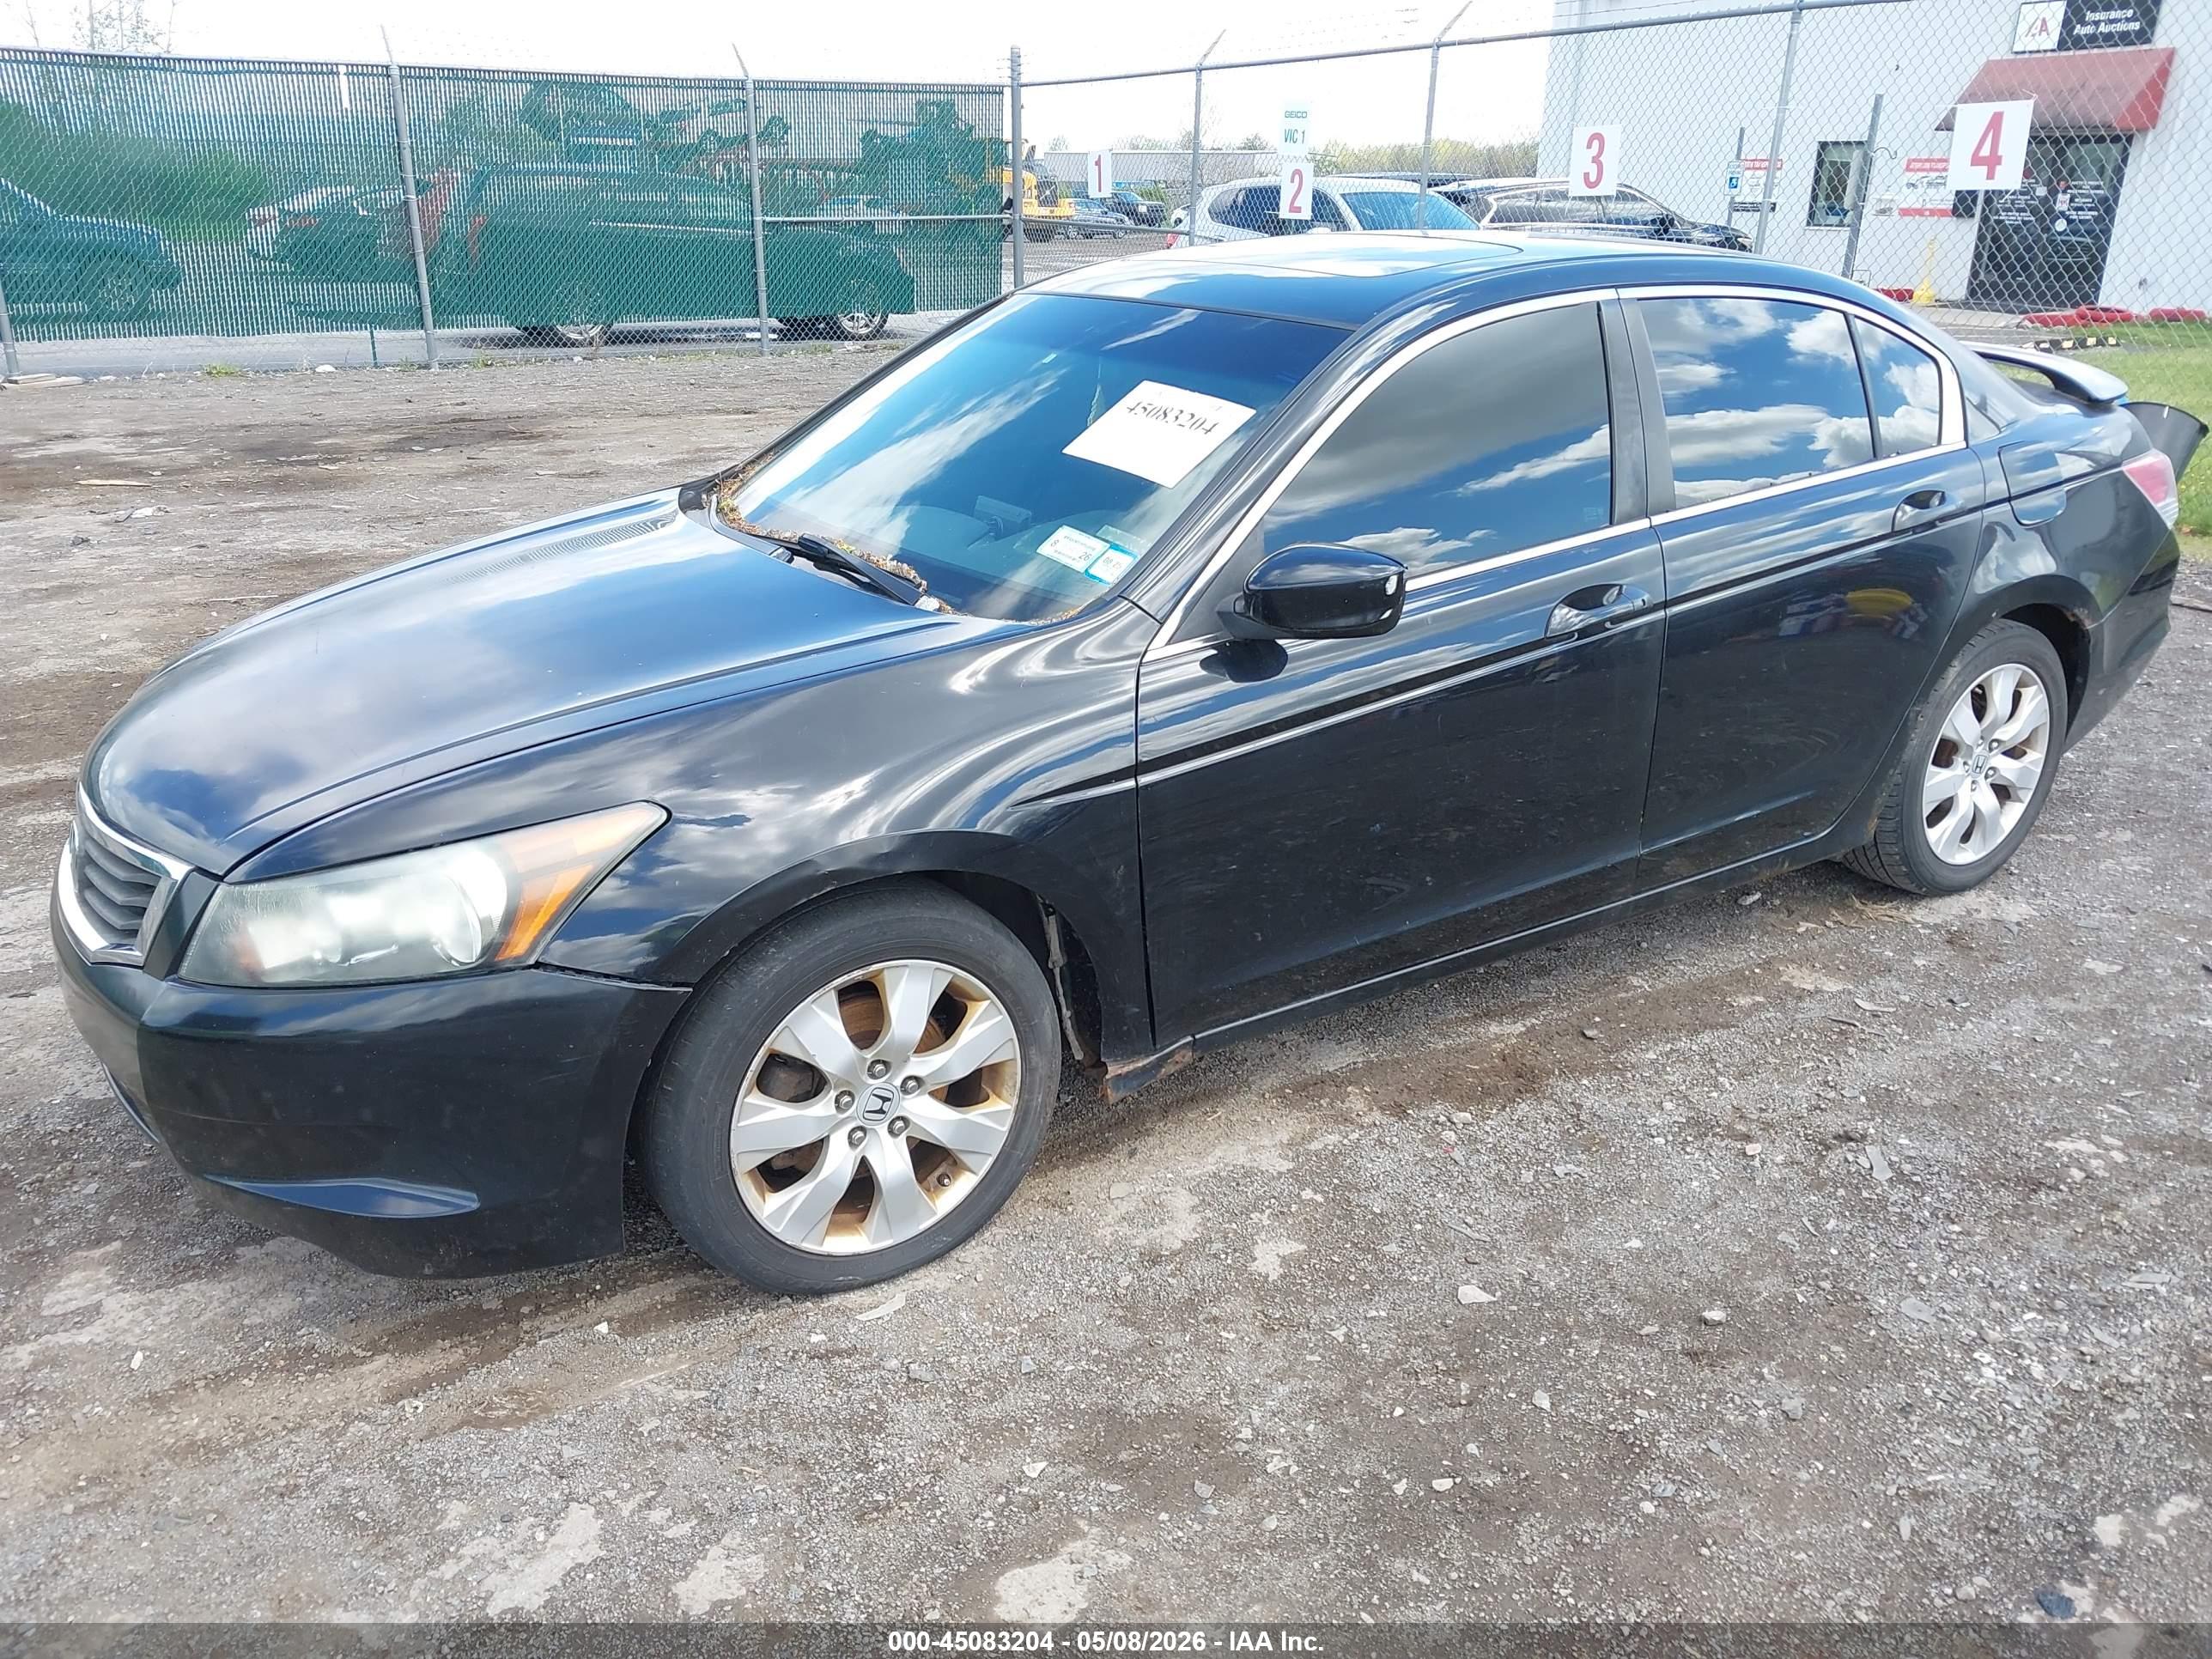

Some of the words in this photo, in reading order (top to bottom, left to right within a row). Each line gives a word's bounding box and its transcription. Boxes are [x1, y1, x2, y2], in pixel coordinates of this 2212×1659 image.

[2073, 24, 2095, 35] Auto
[2098, 21, 2141, 33] Auctions
[2085, 9, 2134, 21] Insurance
[1285, 129, 1298, 143] VIC
[1302, 130, 1305, 144] 1
[1970, 111, 2004, 180] 4
[1095, 155, 1102, 192] 1
[1583, 132, 1605, 189] 3
[1289, 168, 1304, 213] 2
[1127, 401, 1219, 434] 45083204
